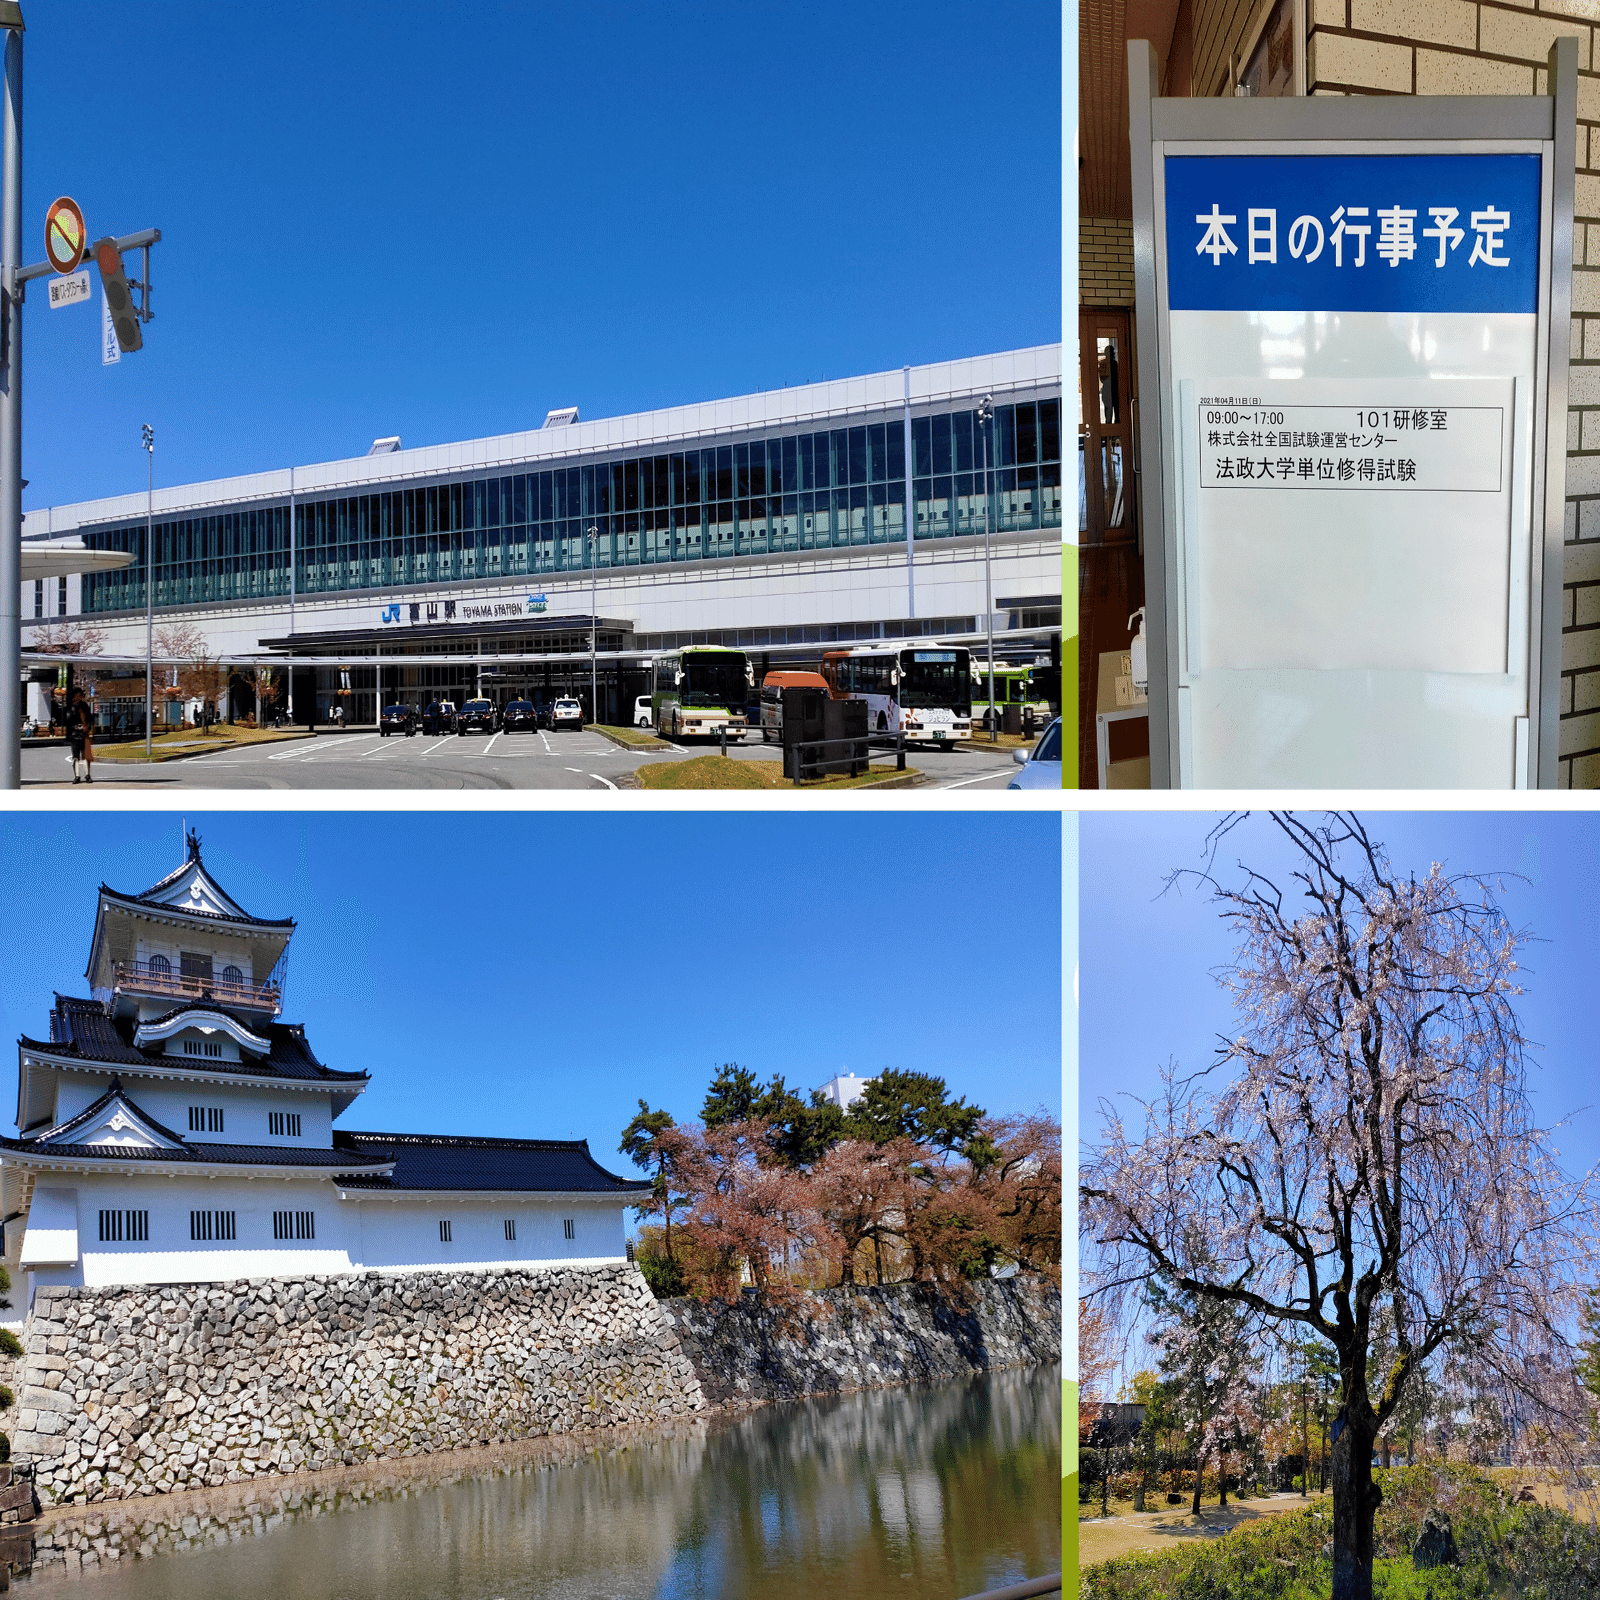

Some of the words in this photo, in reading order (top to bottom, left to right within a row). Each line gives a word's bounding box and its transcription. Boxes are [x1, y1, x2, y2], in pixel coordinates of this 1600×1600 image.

[1195, 203, 1511, 268] 本日の行事予定
[1356, 409, 1448, 431] 101研修室
[1207, 431, 1398, 449] 株式会社全国試験運営センター
[1215, 456, 1417, 481] 法政大学単位修得試験
[382, 604, 400, 623] JR
[463, 605, 492, 618] TOYAMA
[494, 603, 522, 617] STATION
